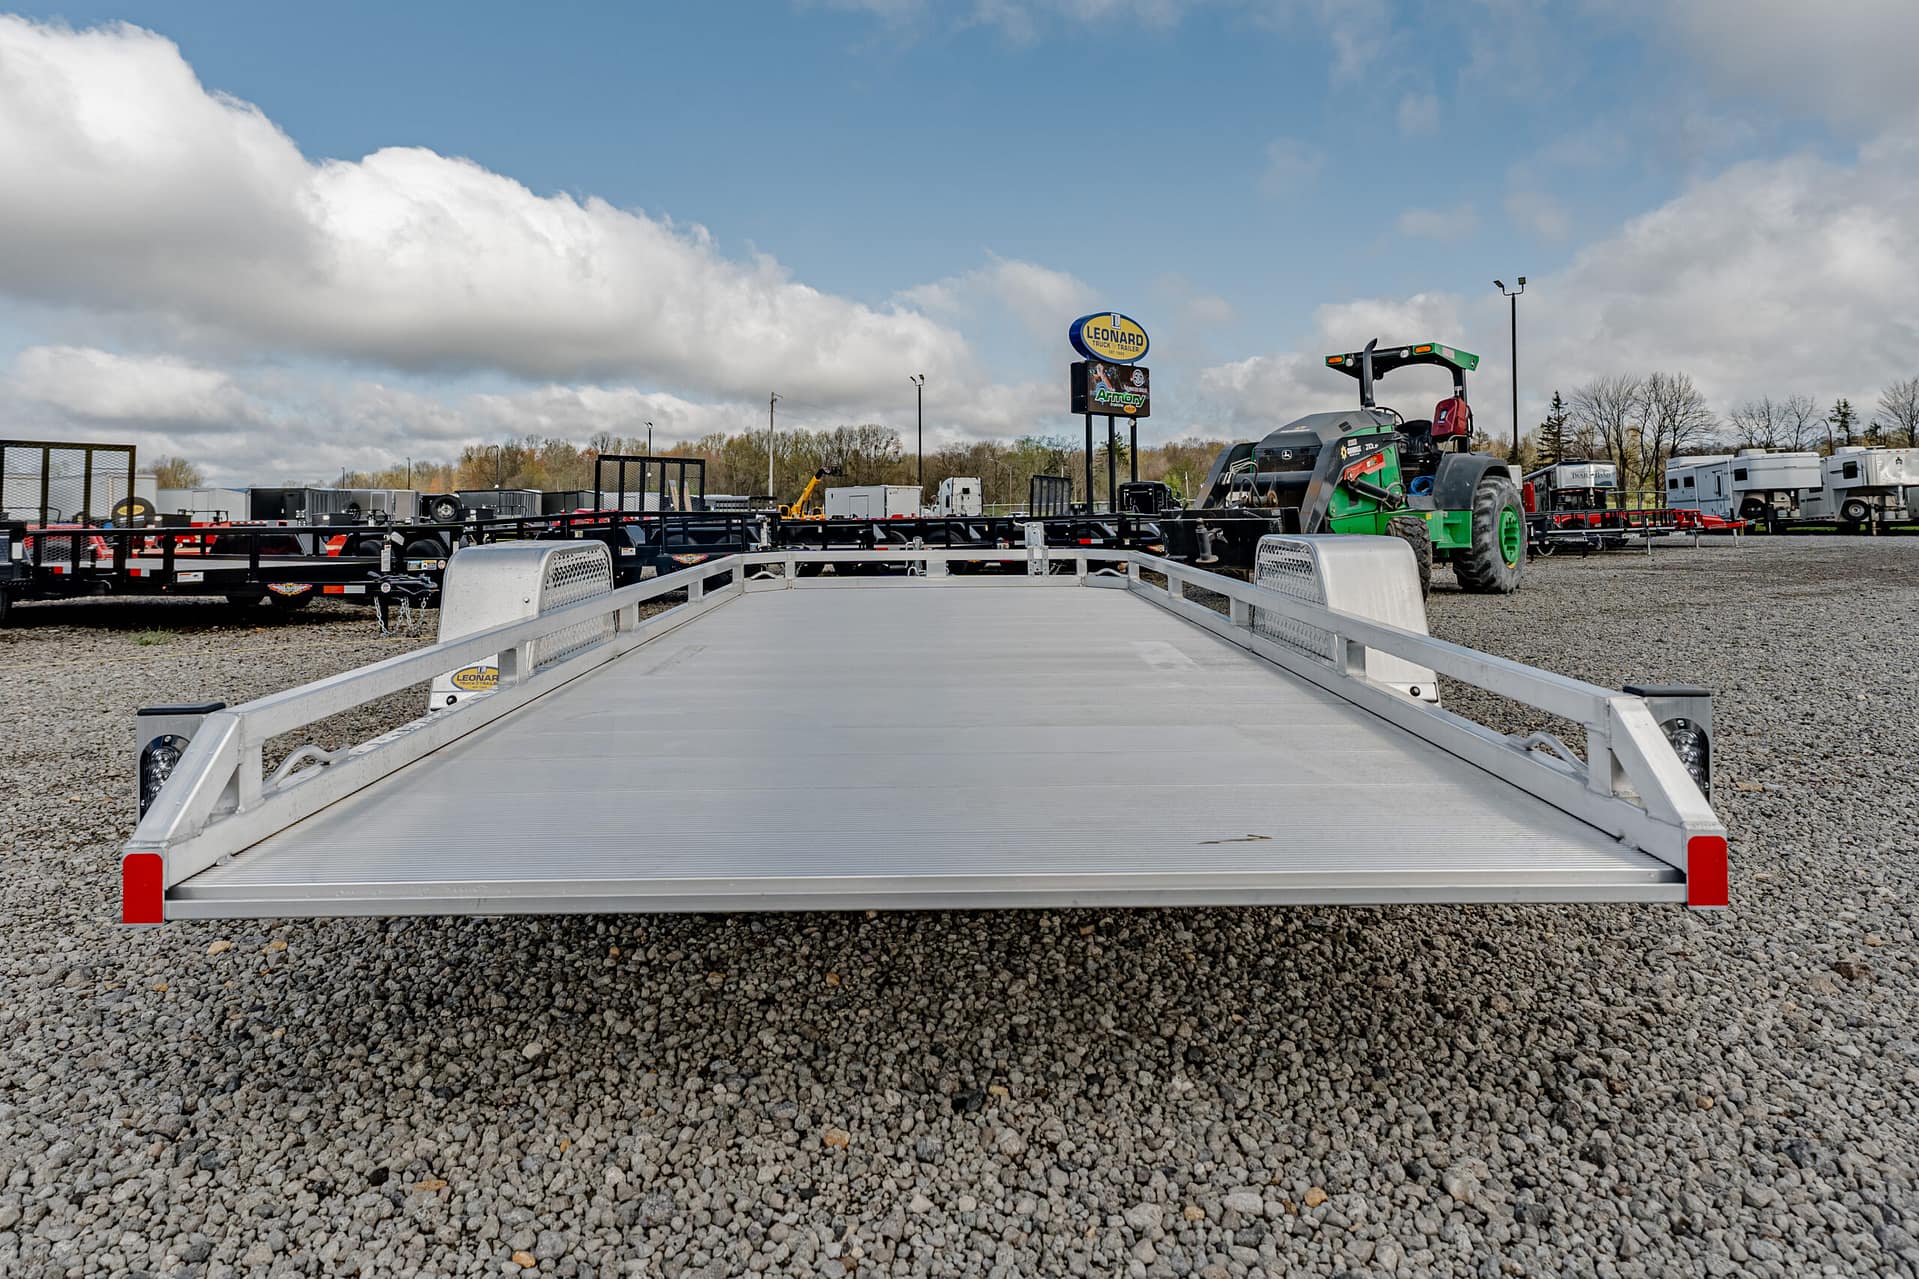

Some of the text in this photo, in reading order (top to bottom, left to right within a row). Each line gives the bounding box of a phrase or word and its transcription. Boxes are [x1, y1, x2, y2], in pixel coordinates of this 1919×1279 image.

[1087, 325, 1143, 346] LEONARD
[1092, 339, 1111, 348] TRUCK
[1117, 343, 1140, 352] TRAILER
[1095, 388, 1145, 407] Armory
[457, 674, 499, 682] LEONAR
